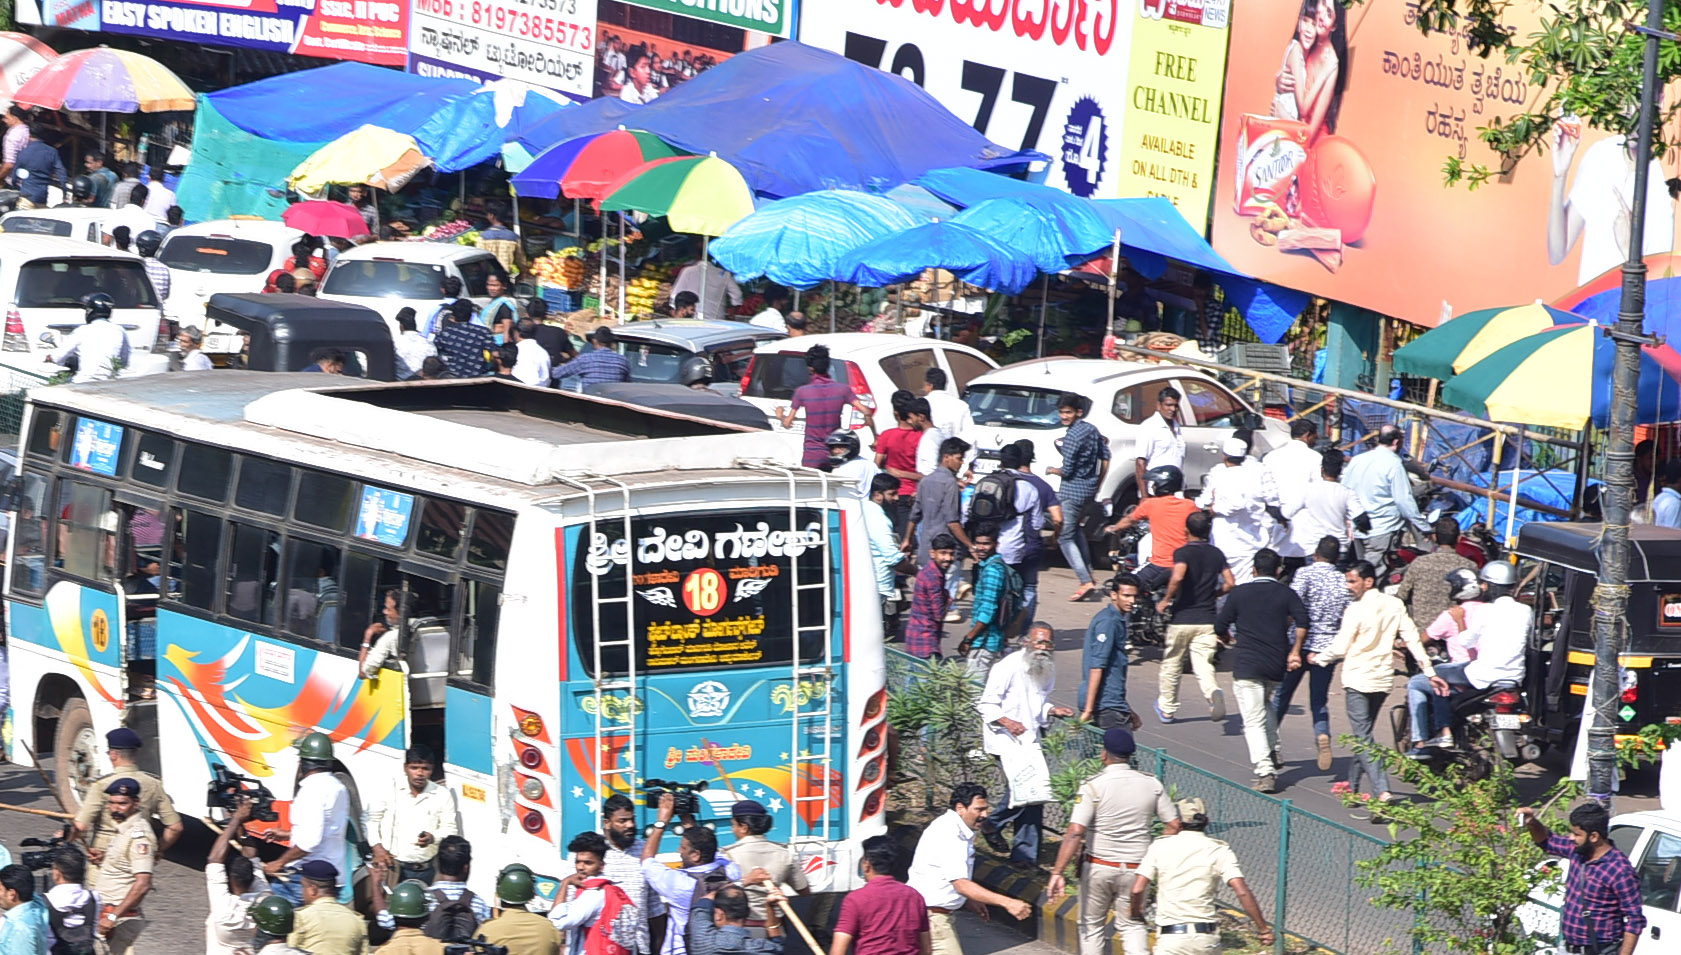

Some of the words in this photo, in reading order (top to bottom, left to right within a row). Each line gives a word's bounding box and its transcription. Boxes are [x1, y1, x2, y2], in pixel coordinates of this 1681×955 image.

[102, 0, 147, 28] EASY
[147, 5, 218, 36] SPOKEN
[219, 12, 295, 44] ENGLISH
[368, 1, 400, 22] PUC
[471, 1, 592, 51] 8197385573
[1204, 7, 1227, 22] NEWS
[1154, 51, 1198, 82] FREE
[1382, 50, 1466, 91] ಕಾಂತಿಯುತ
[1471, 62, 1528, 115] ತ್ವಚೆಯ
[1133, 85, 1212, 124] CHANNEL
[1080, 115, 1103, 184] 4
[1141, 134, 1196, 160] AVAILABLE
[1425, 102, 1469, 159] ರಹಸ್ಯ
[1132, 160, 1147, 176] ON
[1149, 164, 1167, 183] ALL
[1169, 168, 1190, 188] DTH
[1254, 150, 1294, 186] SANTOOR
[585, 533, 631, 575] ಶ್ರೀ
[637, 526, 710, 564] ದೇವಿ
[714, 522, 822, 560] ಗಣೇಶ್
[684, 572, 719, 611] 18
